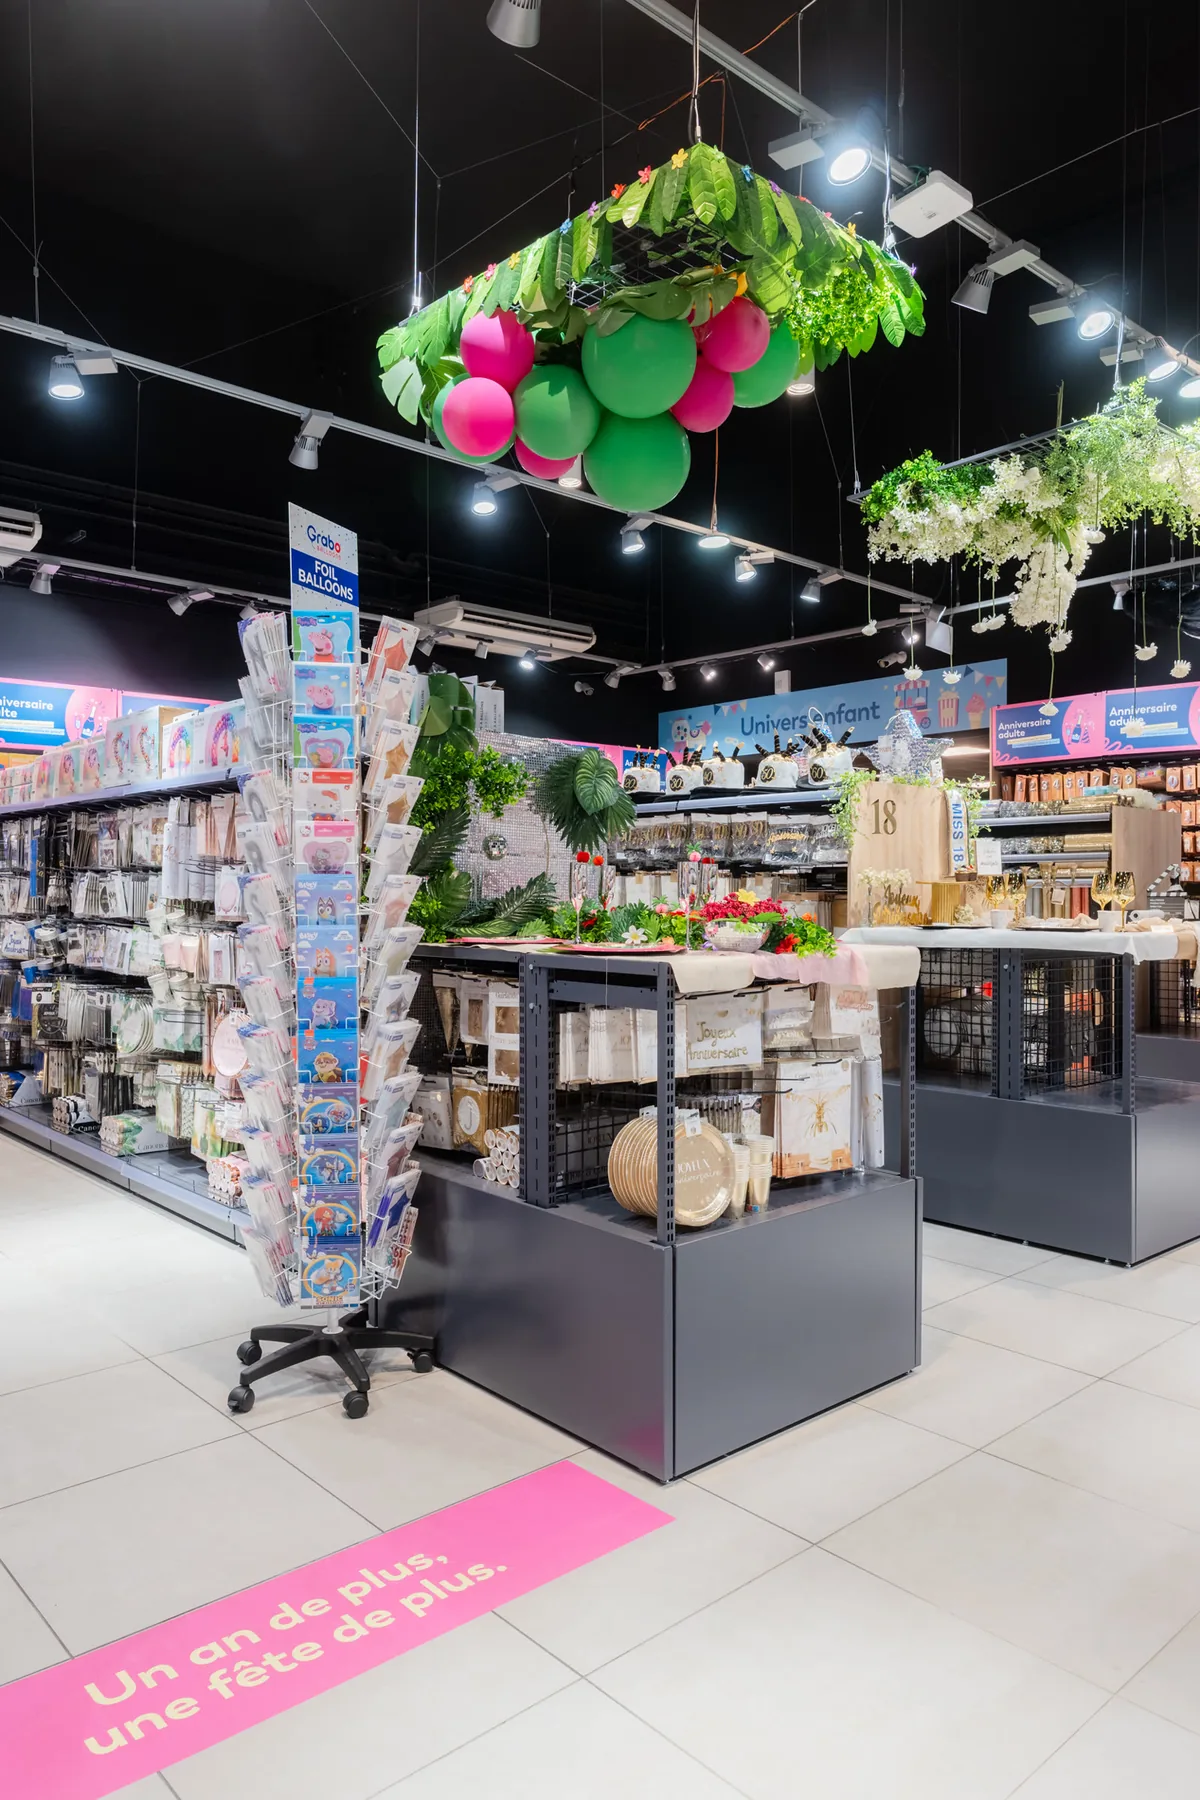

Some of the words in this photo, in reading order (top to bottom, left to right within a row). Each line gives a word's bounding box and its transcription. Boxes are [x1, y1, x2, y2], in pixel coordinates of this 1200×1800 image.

[307, 525, 341, 553] Grabo
[315, 560, 338, 581] FOIL
[298, 568, 354, 601] BALLOONS
[0, 706, 18, 718] lte
[741, 714, 808, 736] Univers
[813, 701, 881, 726] enfant
[1109, 702, 1178, 717] Anniversaire
[998, 718, 1052, 732] Anniversaire
[998, 729, 1026, 740] adulte
[811, 767, 824, 779] 60
[872, 798, 897, 835] 18
[952, 803, 964, 840] MISS
[953, 847, 965, 862] 18
[696, 1021, 737, 1047] Joyeux
[687, 1041, 749, 1060] Anniversaire
[83, 1663, 179, 1706] Un
[189, 1629, 261, 1666] an
[269, 1598, 332, 1632] de
[338, 1552, 449, 1607] plus,
[83, 1697, 201, 1756] une
[207, 1641, 325, 1701] fête
[333, 1609, 396, 1644] de
[400, 1563, 509, 1619] plus.
